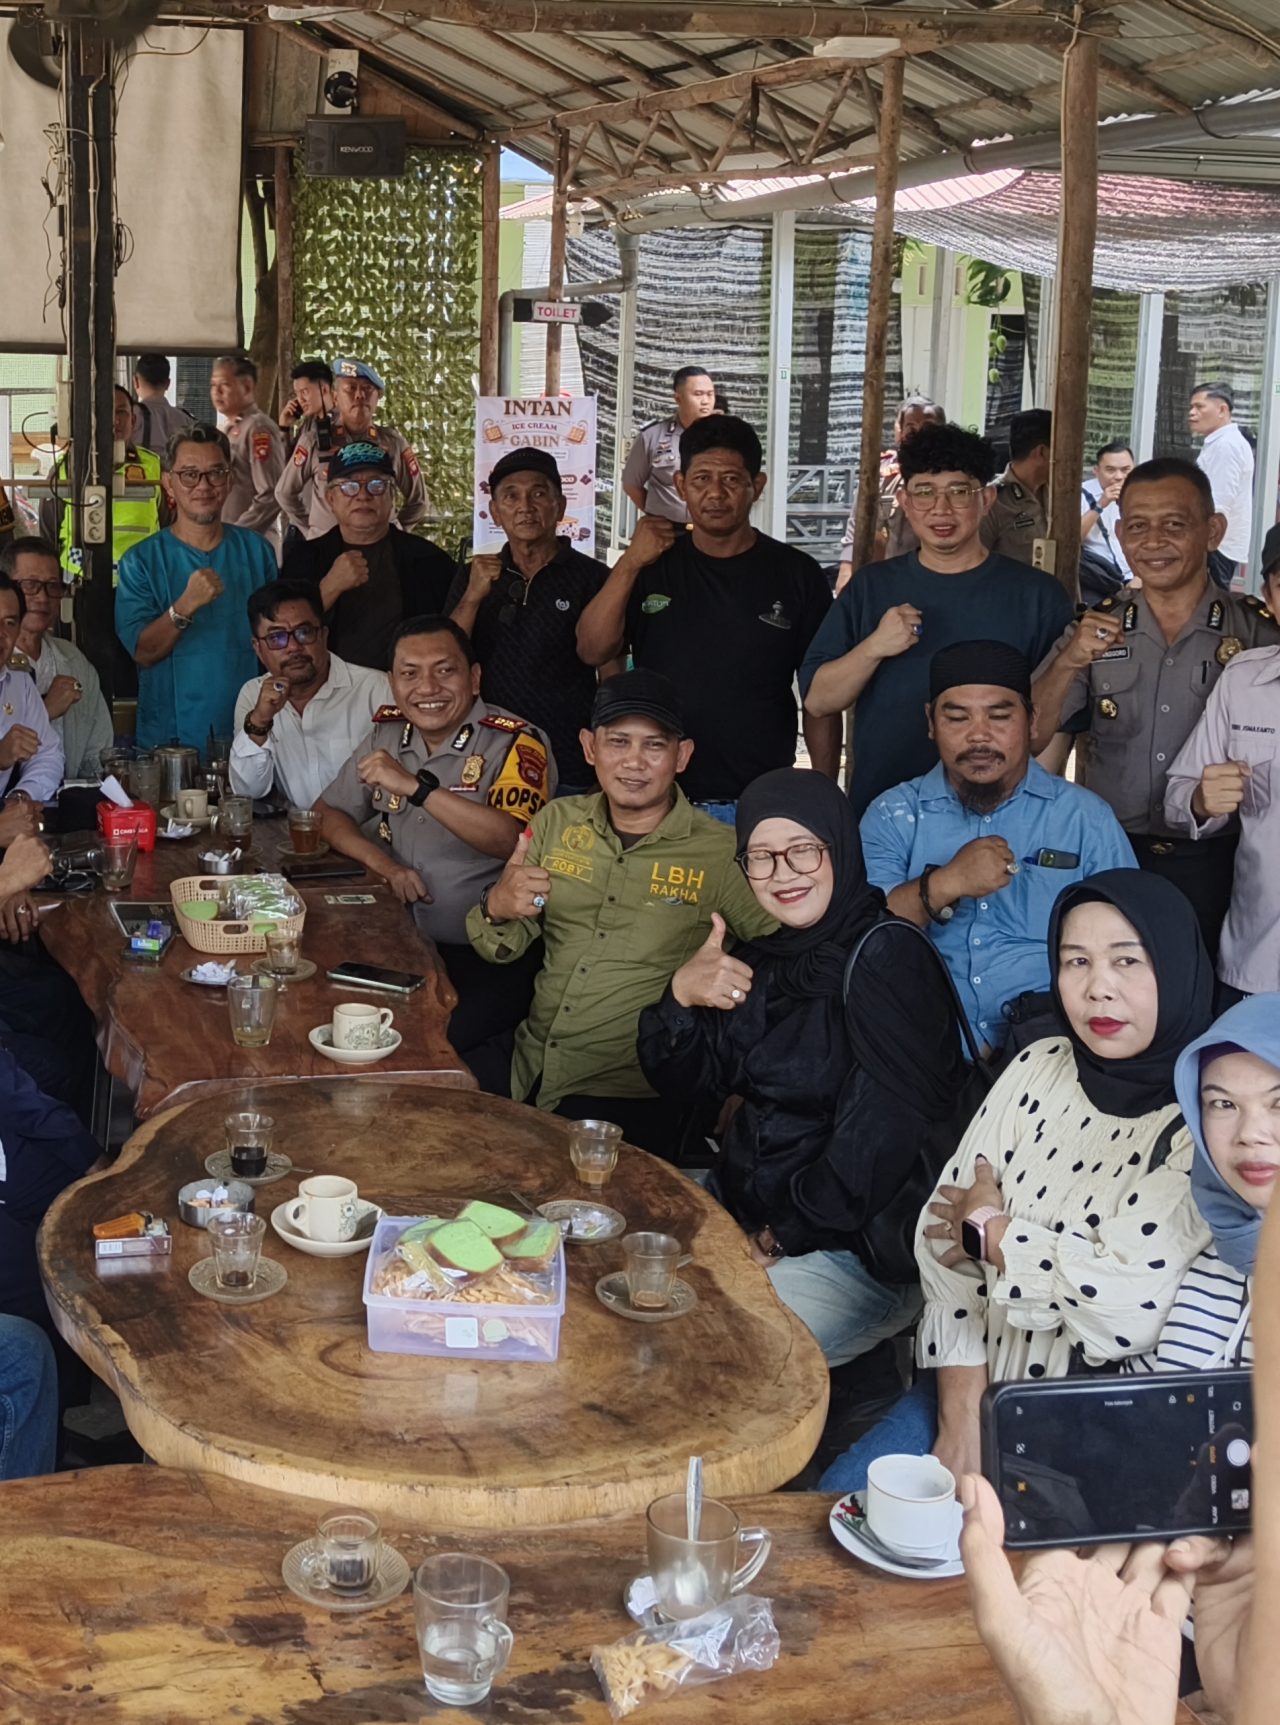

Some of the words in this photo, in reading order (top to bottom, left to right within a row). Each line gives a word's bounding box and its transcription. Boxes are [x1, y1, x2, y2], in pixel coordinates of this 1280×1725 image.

[537, 306, 577, 319] TOILET
[503, 400, 573, 417] INTAN
[512, 422, 526, 431] ICE
[527, 422, 558, 431] CREAM
[509, 434, 561, 448] GABIN
[551, 859, 585, 877] ROBY
[651, 861, 706, 889] LBH
[650, 883, 699, 902] RAKHA
